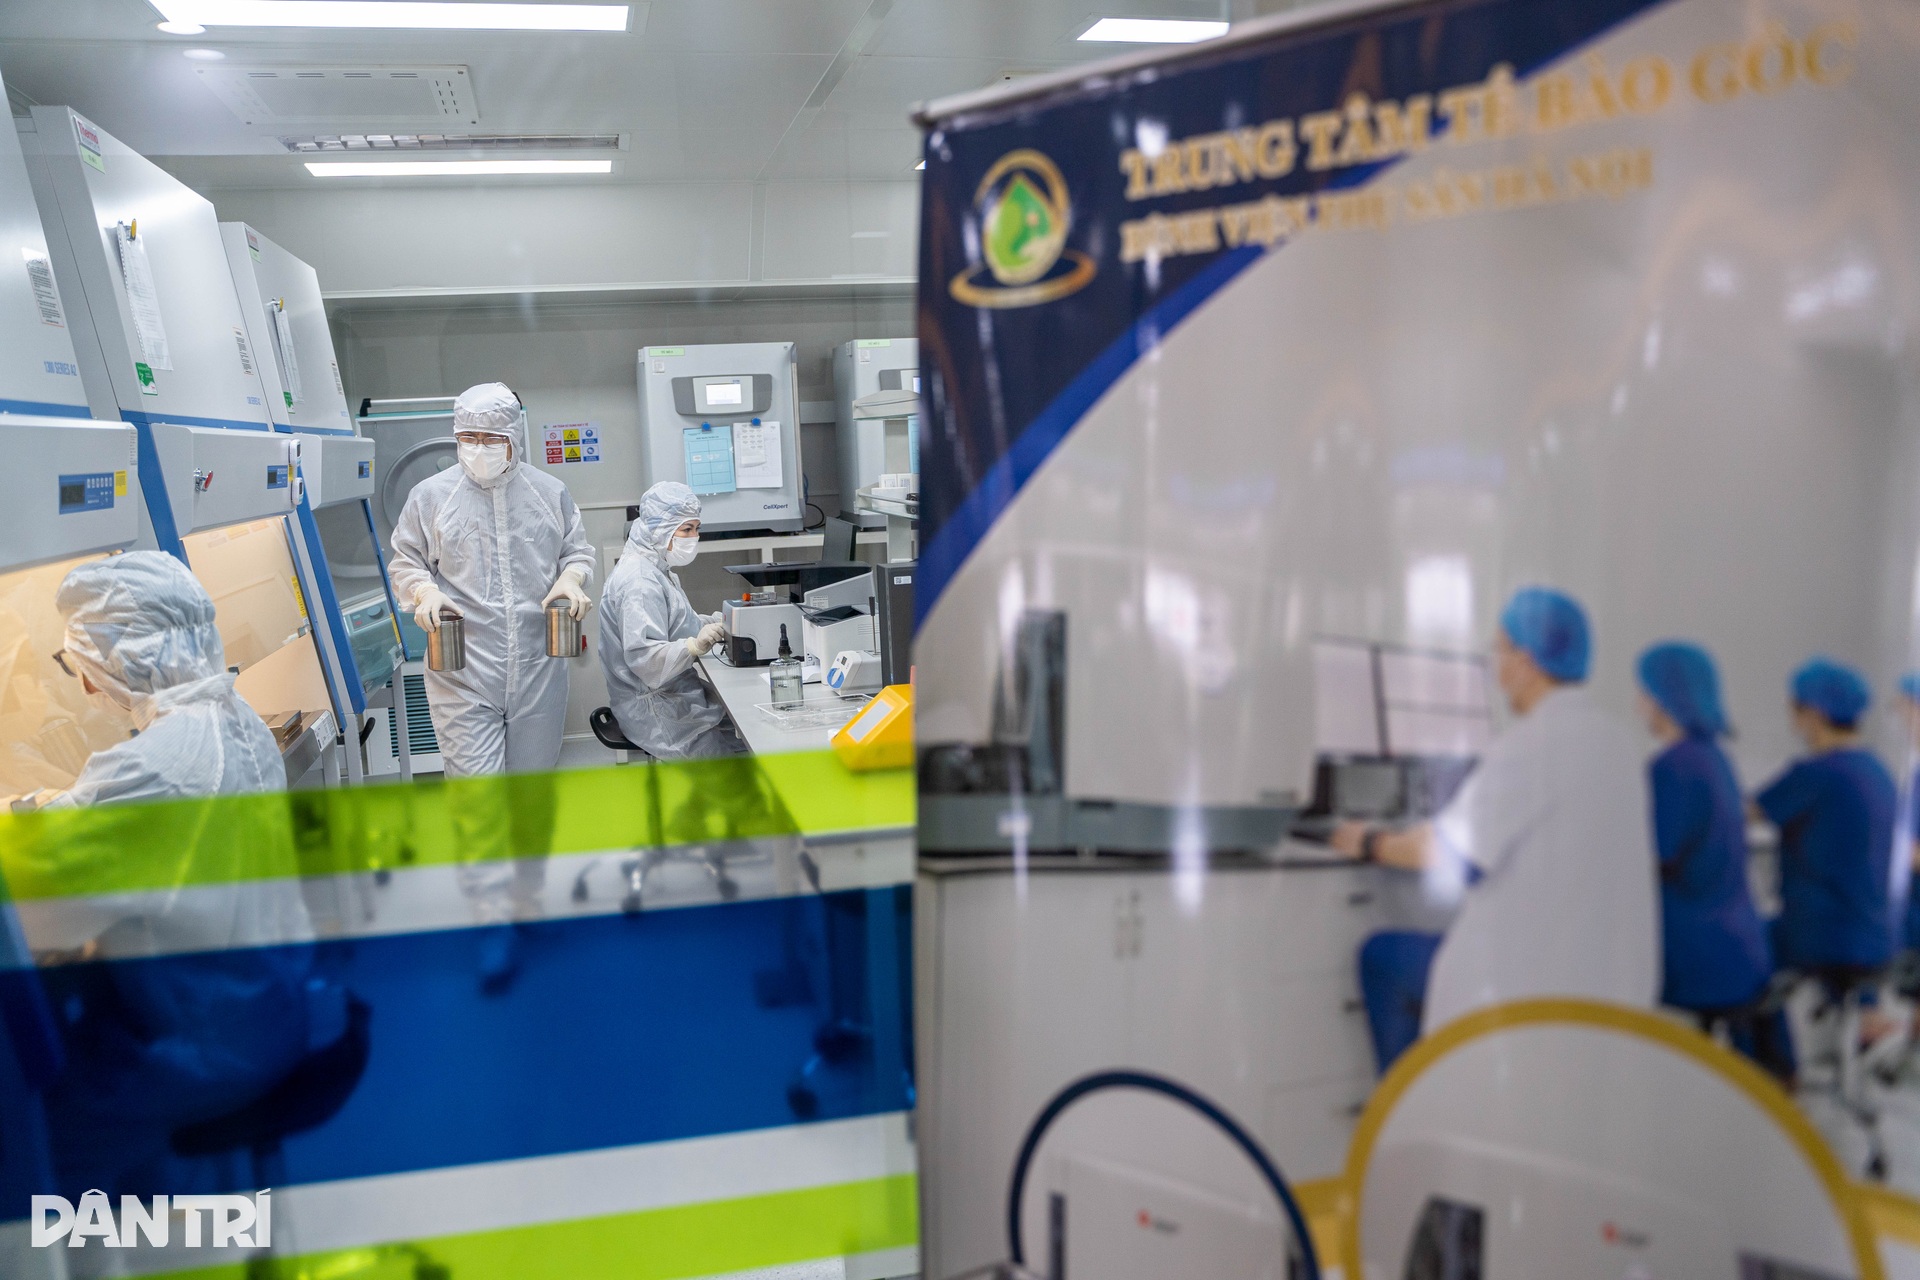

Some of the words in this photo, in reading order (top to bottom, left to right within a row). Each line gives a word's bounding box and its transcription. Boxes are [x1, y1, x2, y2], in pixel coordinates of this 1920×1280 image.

[1119, 118, 1298, 200] TRUNG
[1302, 92, 1432, 172] TÂM
[1532, 50, 1673, 132] BÀO
[763, 503, 789, 511] CellXpert
